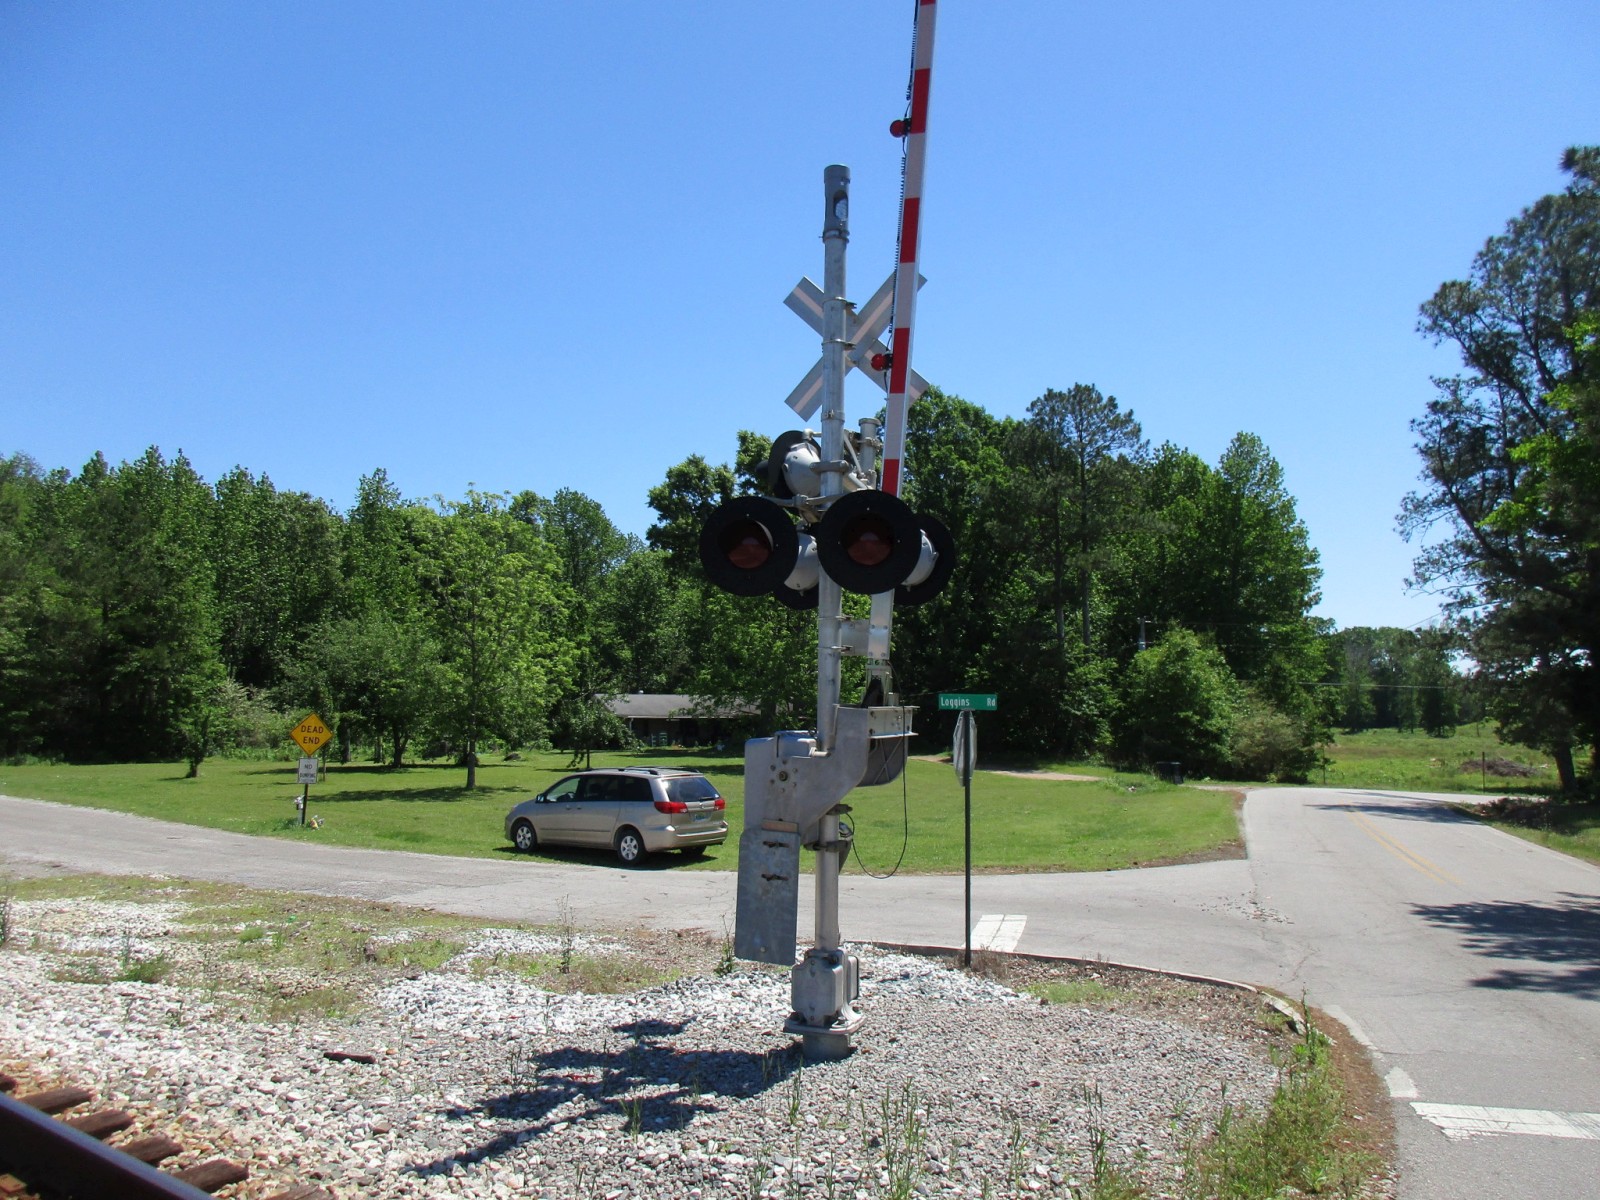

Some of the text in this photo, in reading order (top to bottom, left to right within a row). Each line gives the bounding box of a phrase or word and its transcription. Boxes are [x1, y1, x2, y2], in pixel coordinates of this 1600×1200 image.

[940, 697, 996, 709] Loggins Rd
[300, 725, 324, 734] DEAD
[302, 736, 320, 745] END
